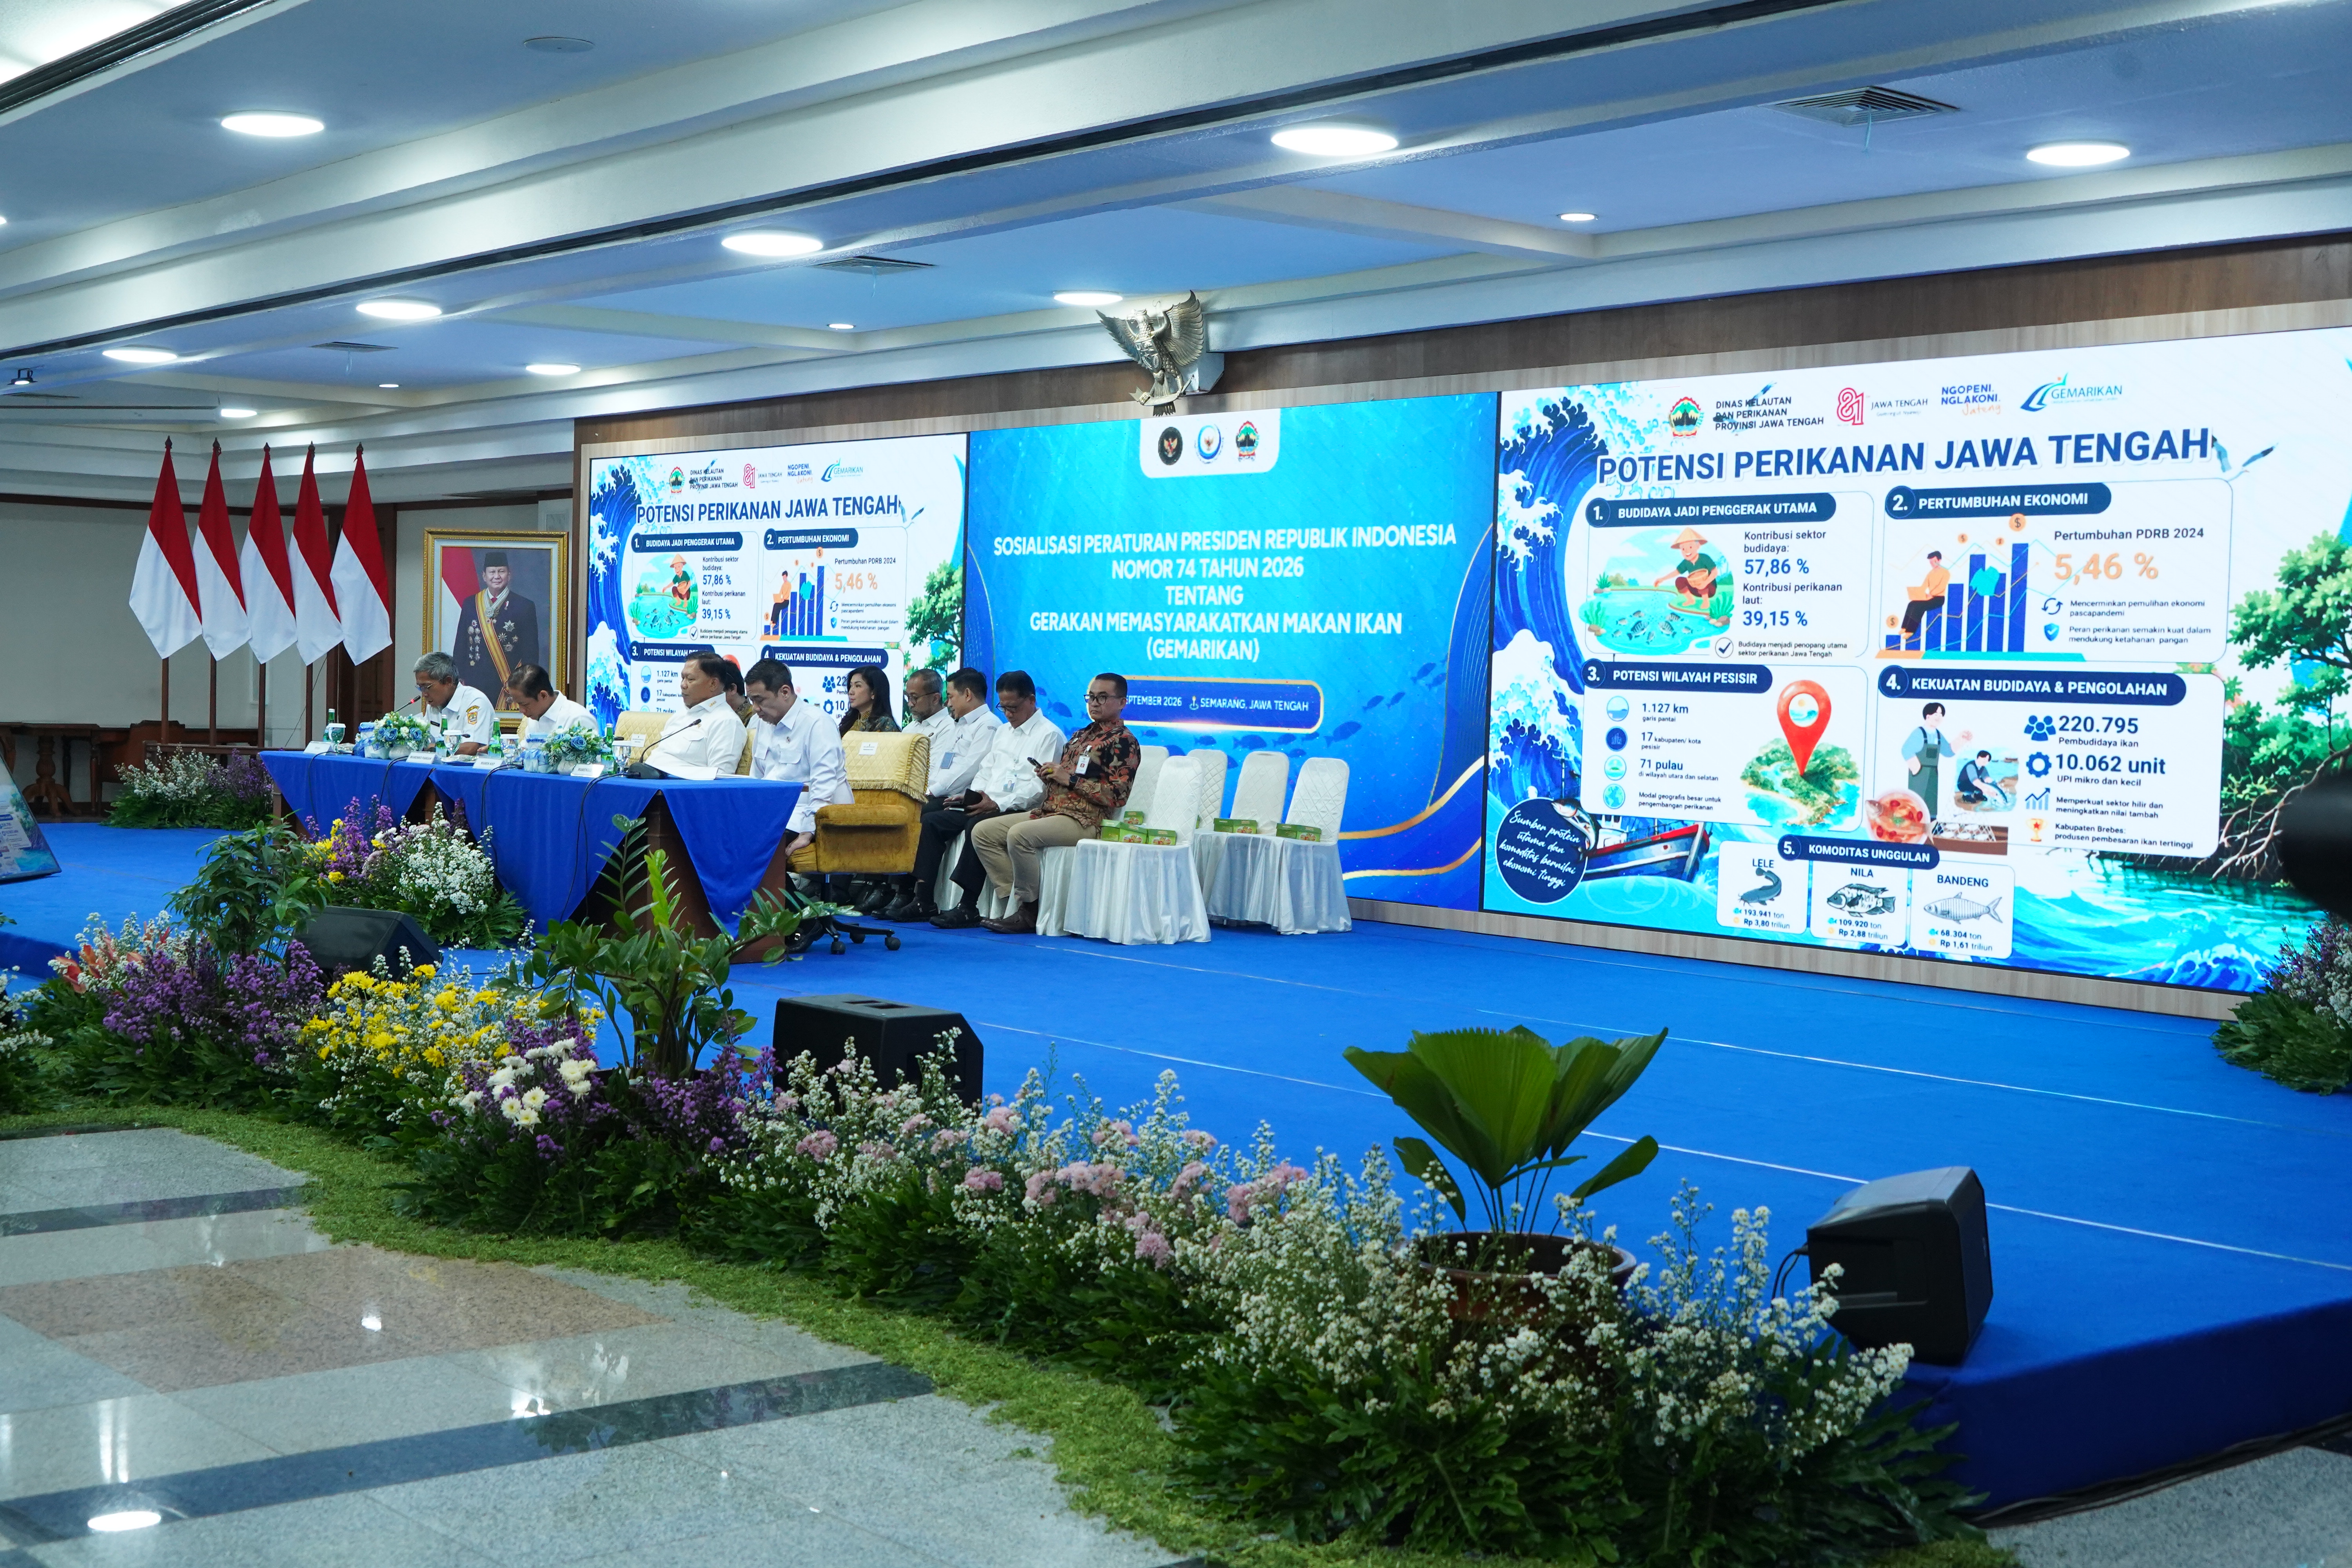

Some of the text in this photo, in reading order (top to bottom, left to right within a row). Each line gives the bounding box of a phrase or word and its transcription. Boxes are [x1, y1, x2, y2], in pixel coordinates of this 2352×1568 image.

[2051, 385, 2122, 399] GEMARIKAN
[1716, 397, 1791, 408] DINAS KELAUTAN
[1737, 408, 1787, 418] PERIKANAN
[1715, 417, 1824, 431] PROVINSI JAWA TENGAH
[1599, 428, 2208, 483] POTENSI PERIKANAN JAWA TENGAH
[1893, 493, 2087, 510] 2. PERTUMBUHAN EKONOMI
[637, 495, 897, 523] POTENSI PERIKANAN JAWA TENGAH
[1593, 502, 1817, 520] 1. BUDIDAYA JADI PENGGERAK UTAMA
[767, 534, 773, 544] 2.
[778, 535, 821, 544] PERTUMBUHAN
[994, 524, 1456, 554] SOSIALISASI PERATURAN PRESIDEN REPUBLIK INDONESIA
[1745, 530, 1826, 540] Kontribusi sektor
[2054, 528, 2203, 540] Pertumbuhan PDRB 2024
[635, 538, 639, 548] 1.
[1744, 544, 1789, 554] budidaya:
[1112, 557, 1303, 579] NOMOR 74 TAHUN 2026
[1745, 559, 1809, 577] 57,86 %
[2054, 553, 2158, 586] 5,46 %
[703, 575, 731, 586] 57,86 %
[1744, 583, 1842, 593] Kontribusi perikanan
[1165, 586, 1243, 604] TENTANG
[1743, 595, 1762, 604] laut:
[702, 609, 730, 621] 39,15 %
[1743, 611, 1807, 629] 39,15 %
[1031, 612, 1402, 633] GERAKAN MEMASYARAKATKAN MAKAN IKAN
[632, 646, 638, 656] 3.
[1147, 639, 1259, 661] (GEMARIKAN)
[775, 653, 805, 661] KEKUATAN
[806, 653, 833, 662] BUDIDAYA
[840, 654, 881, 663] PENGOLAHAN
[1588, 666, 1757, 684] 3. POTENSI WILAYAH PESISIR
[1886, 674, 2167, 695] 4. KEKUATAN BUDIDAYA & PENGOLAHAN
[1126, 695, 1182, 706] PTEMBER 2026
[1200, 698, 1309, 711] SEMARANG, JAWA TENGAH
[1643, 703, 1688, 713] 1.127 km
[2059, 716, 2138, 734] 220.795
[1642, 732, 1653, 741] 17
[2059, 737, 2117, 748] Pembudidaya
[1641, 759, 1682, 771] 71 pulau
[2056, 754, 2165, 774] 10.062 unit
[2057, 797, 2103, 805] Memperkuat
[1509, 810, 1580, 843] Sumber protein
[2056, 824, 2095, 835] Kabupaten
[1517, 831, 1565, 853] utama dan
[2160, 840, 2193, 849] tertinggi
[1499, 839, 1576, 874] komoditas bernilai
[1784, 841, 1929, 862] 5. KOMODITAS UNGGULAN
[1753, 858, 1774, 869] LELE
[1503, 857, 1566, 889] ekonomi tinggi
[1851, 868, 1873, 877] NILA
[1938, 875, 1988, 887] BANDENG
[1744, 909, 1770, 918] 193.941
[1754, 920, 1769, 928] 3,80
[1839, 919, 1867, 928] 109.920
[1941, 930, 1967, 938] 68.304
[1940, 940, 1950, 948] Rp
